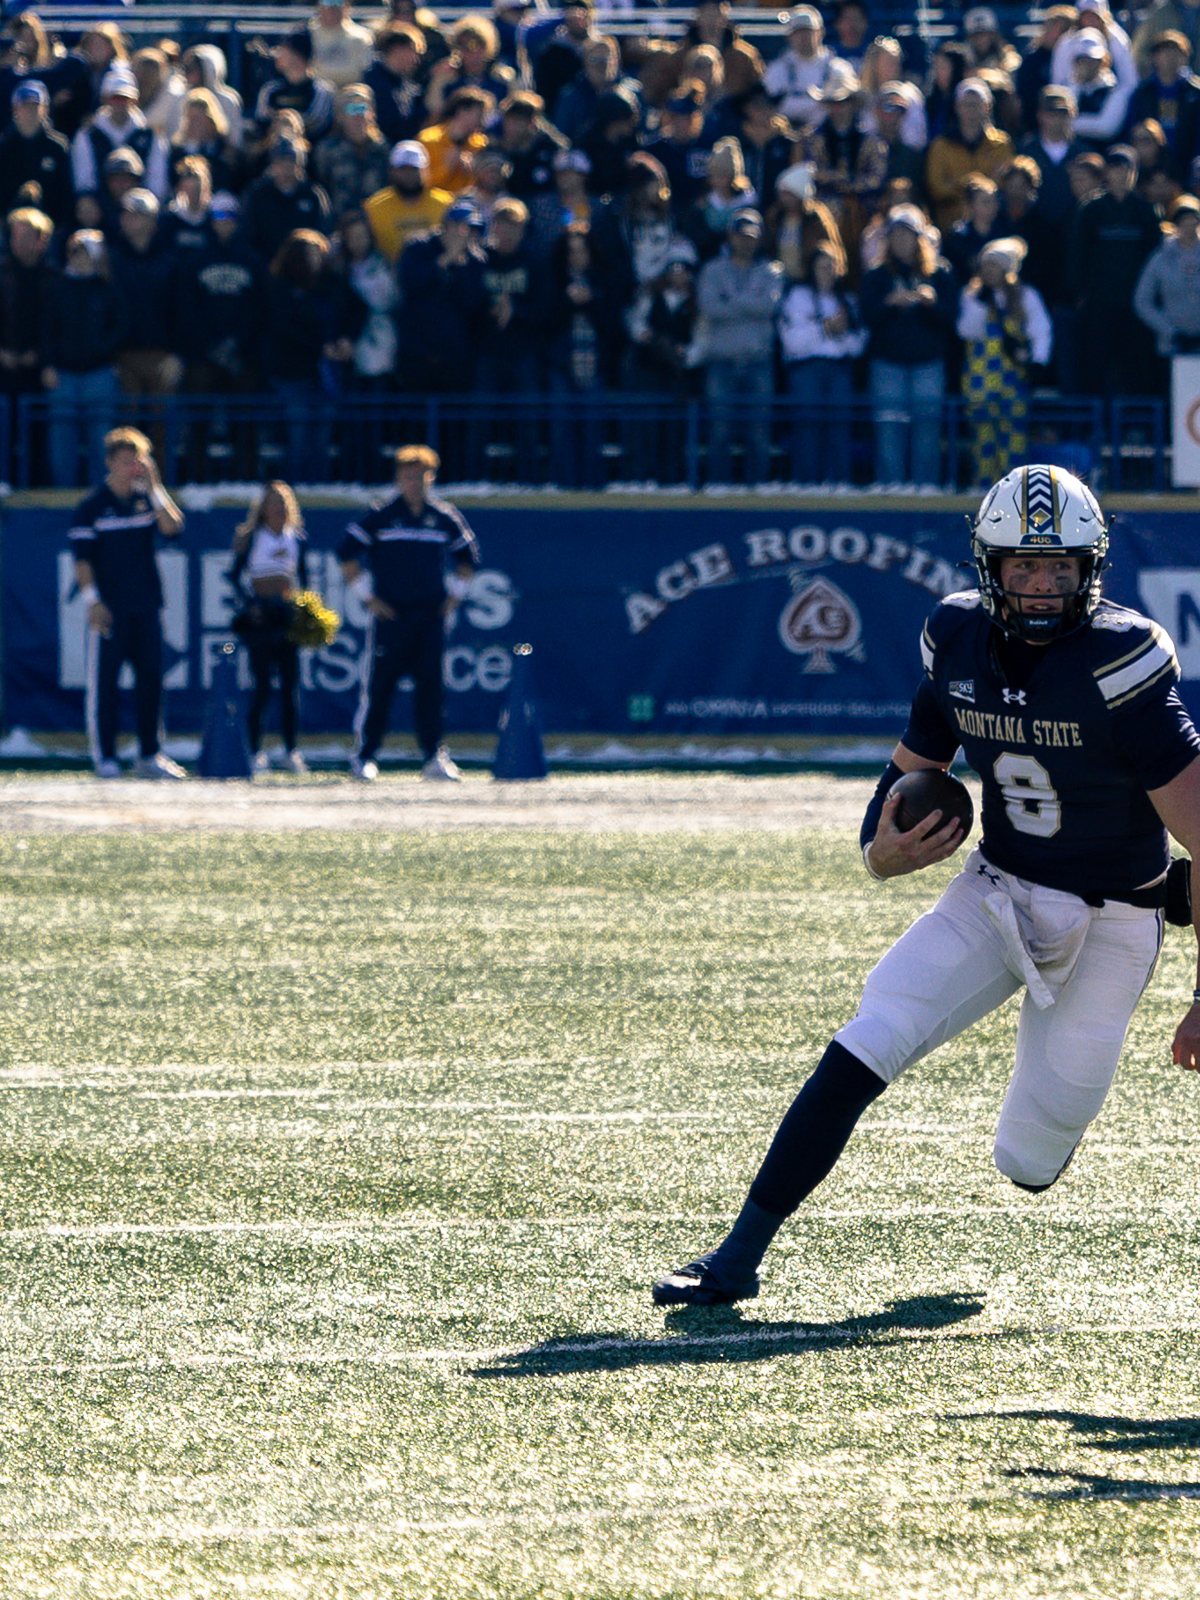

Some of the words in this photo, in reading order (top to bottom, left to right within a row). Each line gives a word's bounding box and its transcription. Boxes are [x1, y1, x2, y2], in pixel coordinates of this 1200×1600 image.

[625, 542, 733, 634] ACE
[745, 525, 974, 598] ROOFIN
[954, 707, 1026, 743] MONTANA
[1033, 719, 1083, 747] STATE
[992, 751, 1062, 838] 8
